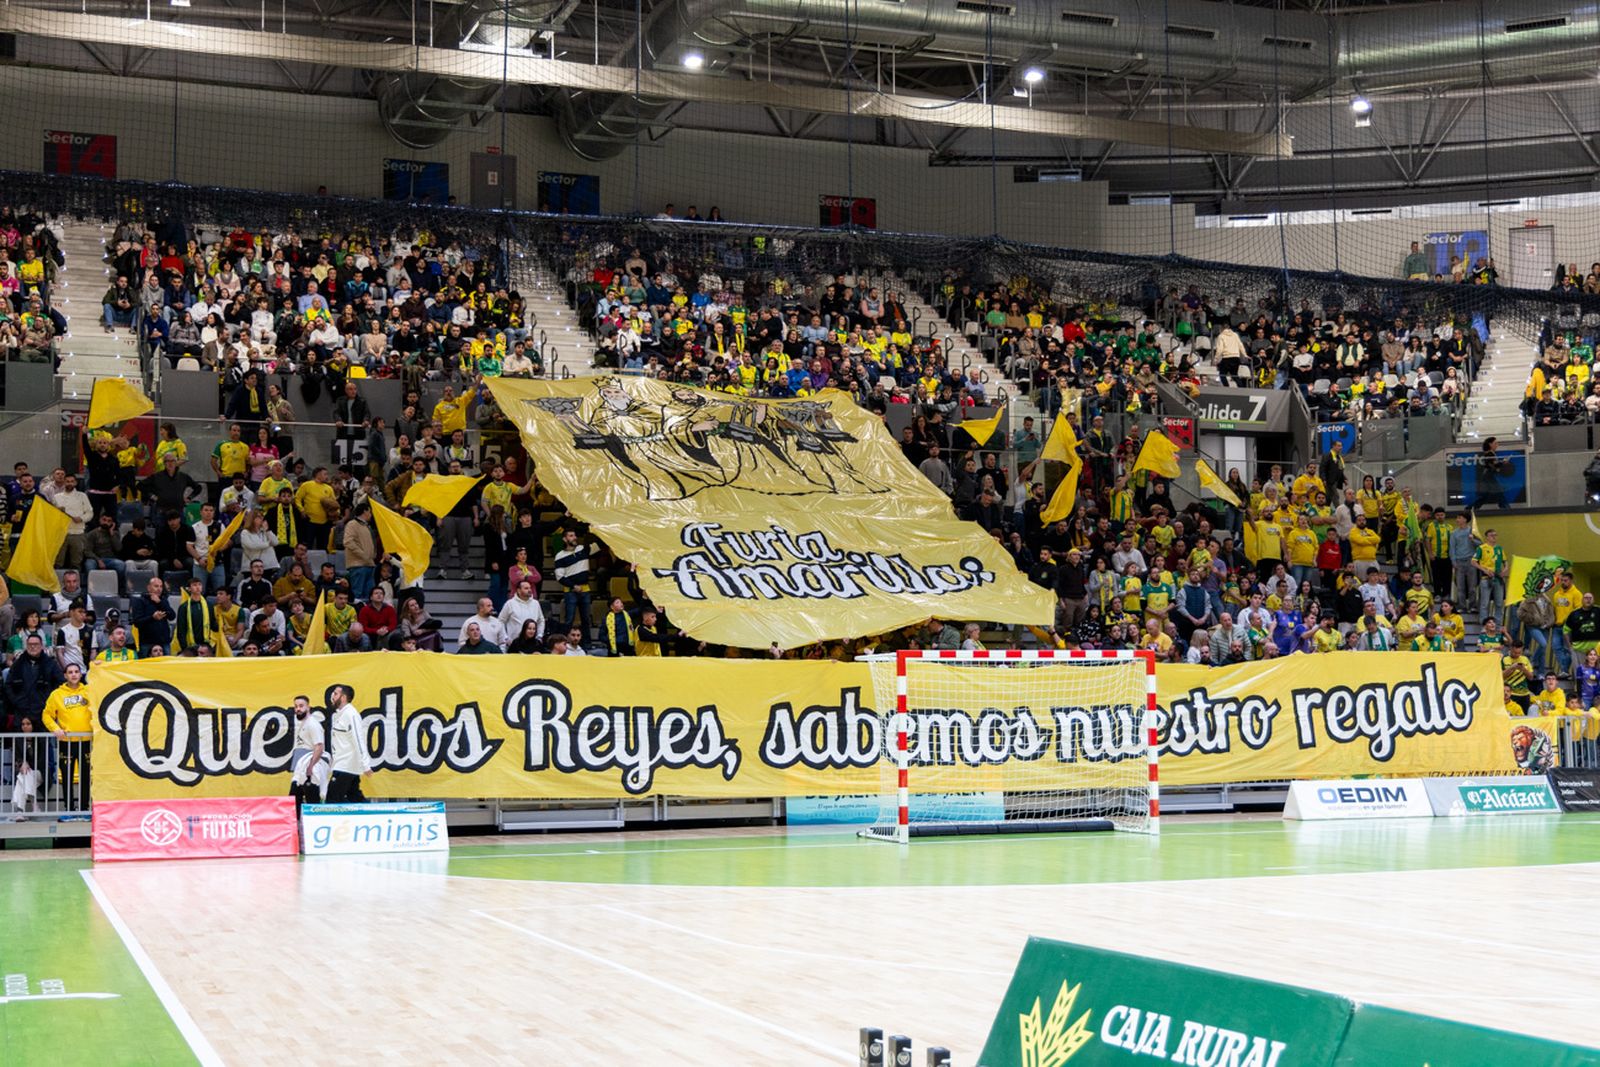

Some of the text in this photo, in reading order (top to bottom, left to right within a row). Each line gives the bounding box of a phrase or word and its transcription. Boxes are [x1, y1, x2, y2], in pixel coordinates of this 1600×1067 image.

[43, 130, 91, 144] Sector
[57, 134, 116, 179] 14
[383, 159, 426, 173] Sector
[537, 172, 578, 186] Sector
[819, 195, 856, 208] Sector
[1423, 233, 1464, 244] Sector
[1199, 396, 1266, 421] alida 7
[1162, 417, 1188, 427] Sector
[1316, 424, 1345, 434] Sector
[334, 438, 369, 466] 15
[681, 521, 844, 566] Furia
[98, 662, 1481, 795] Quedos Reyes, sabemos nuestro regalo
[1317, 786, 1408, 804] OEDIM
[1481, 788, 1546, 809] Alcázar
[202, 821, 254, 839] FUTSAL
[313, 817, 440, 849] géminis
[1100, 1004, 1287, 1067] CAJA RURAL
